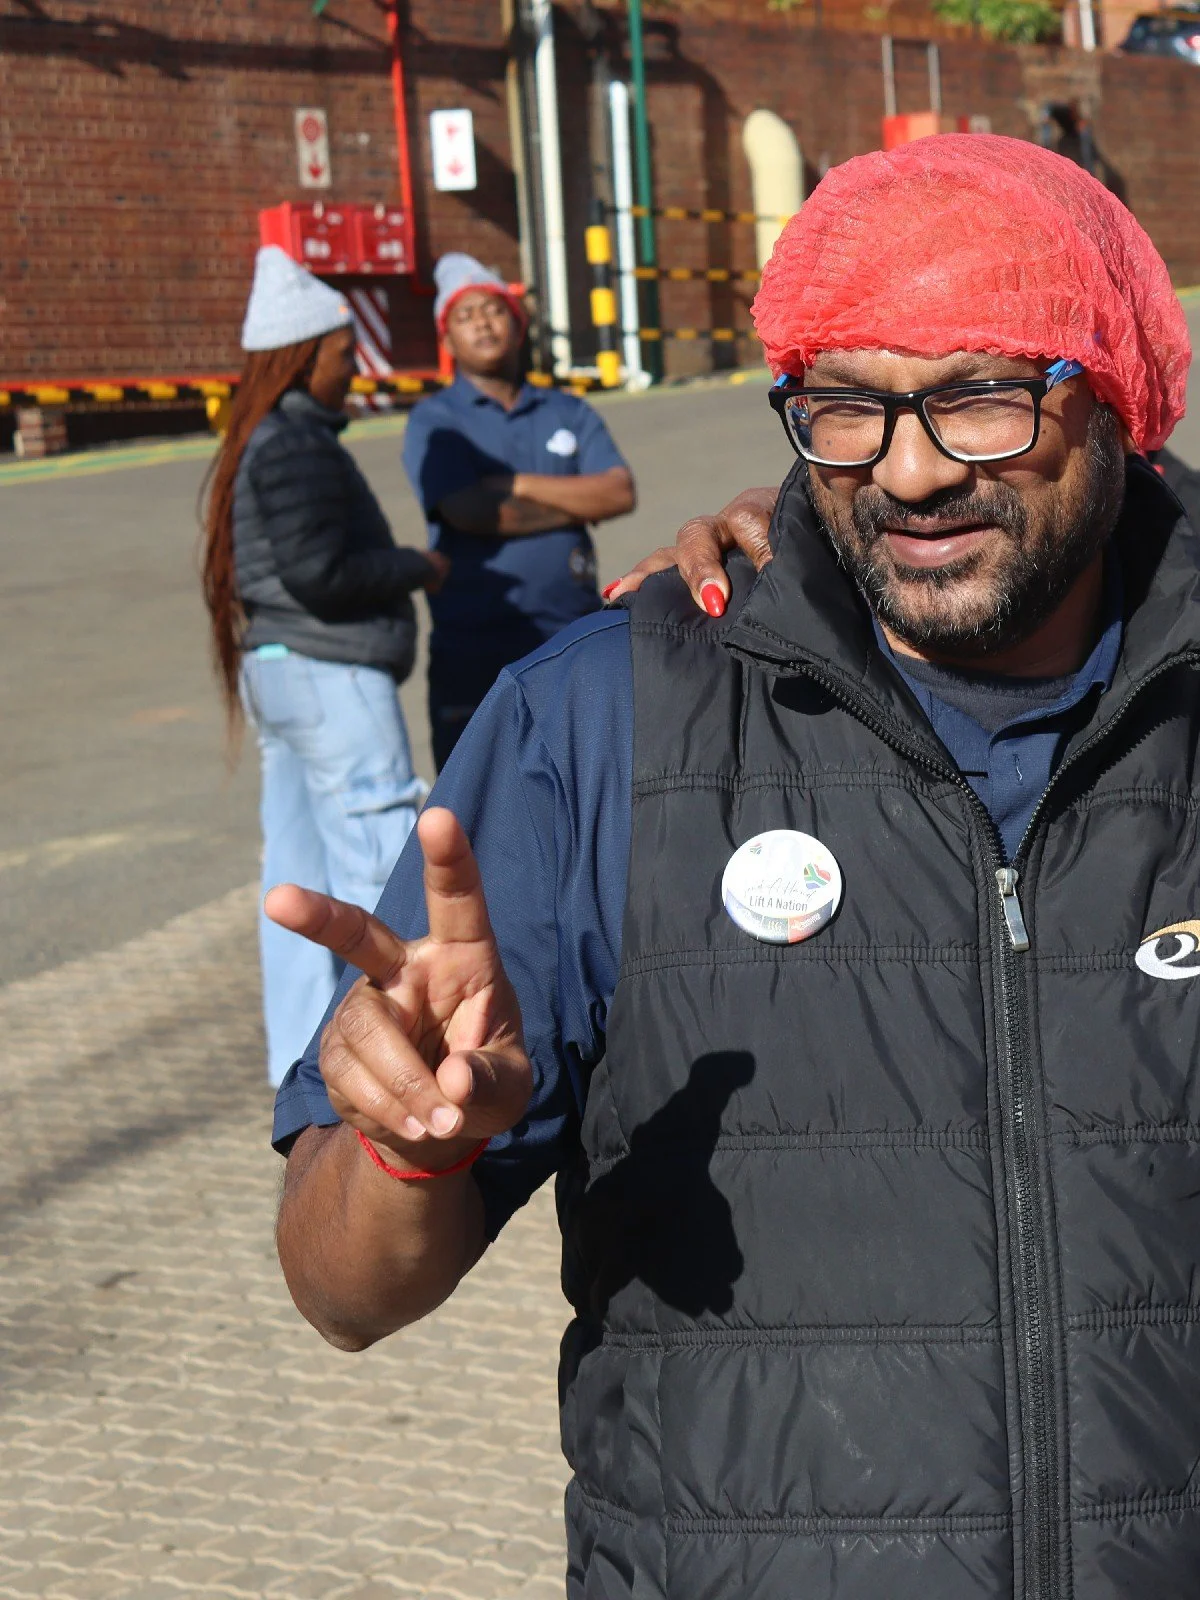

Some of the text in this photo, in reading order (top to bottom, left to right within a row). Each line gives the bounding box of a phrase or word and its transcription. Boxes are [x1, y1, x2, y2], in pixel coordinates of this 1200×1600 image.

[749, 895, 808, 912] Lift A Nation
